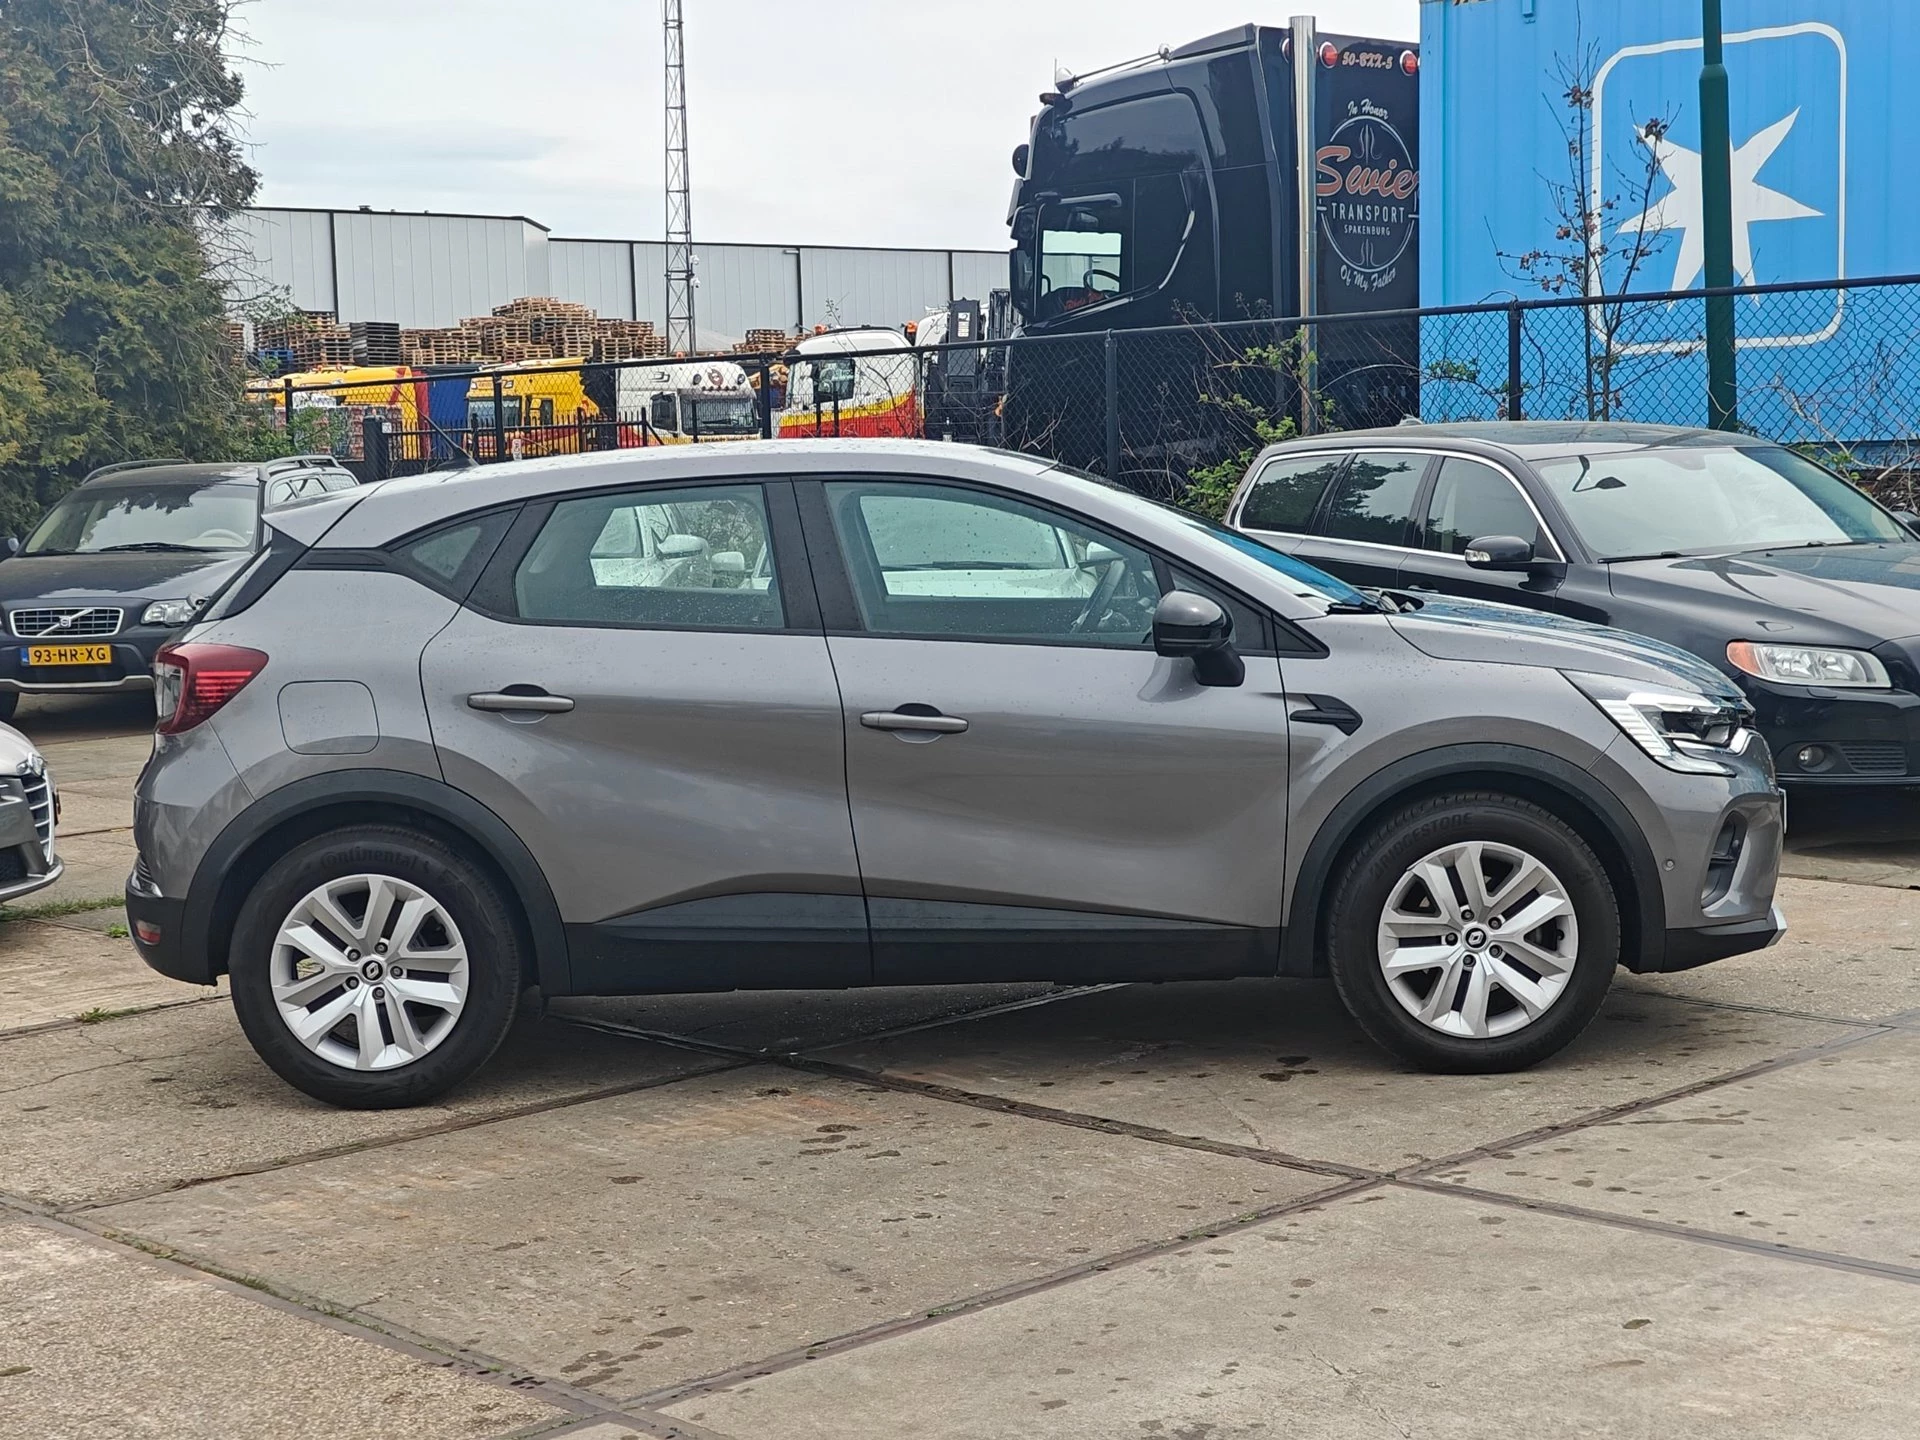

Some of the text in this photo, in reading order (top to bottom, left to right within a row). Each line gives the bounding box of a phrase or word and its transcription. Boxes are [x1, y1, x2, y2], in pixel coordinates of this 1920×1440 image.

[1347, 98, 1389, 120] In Honor
[1316, 145, 1419, 200] Swie
[1331, 202, 1405, 224] TRANSPORT
[1344, 224, 1391, 236] SPAKENBURG
[1340, 264, 1352, 287] Of
[1353, 270, 1368, 293] My
[33, 647, 106, 663] 93-HR-XG
